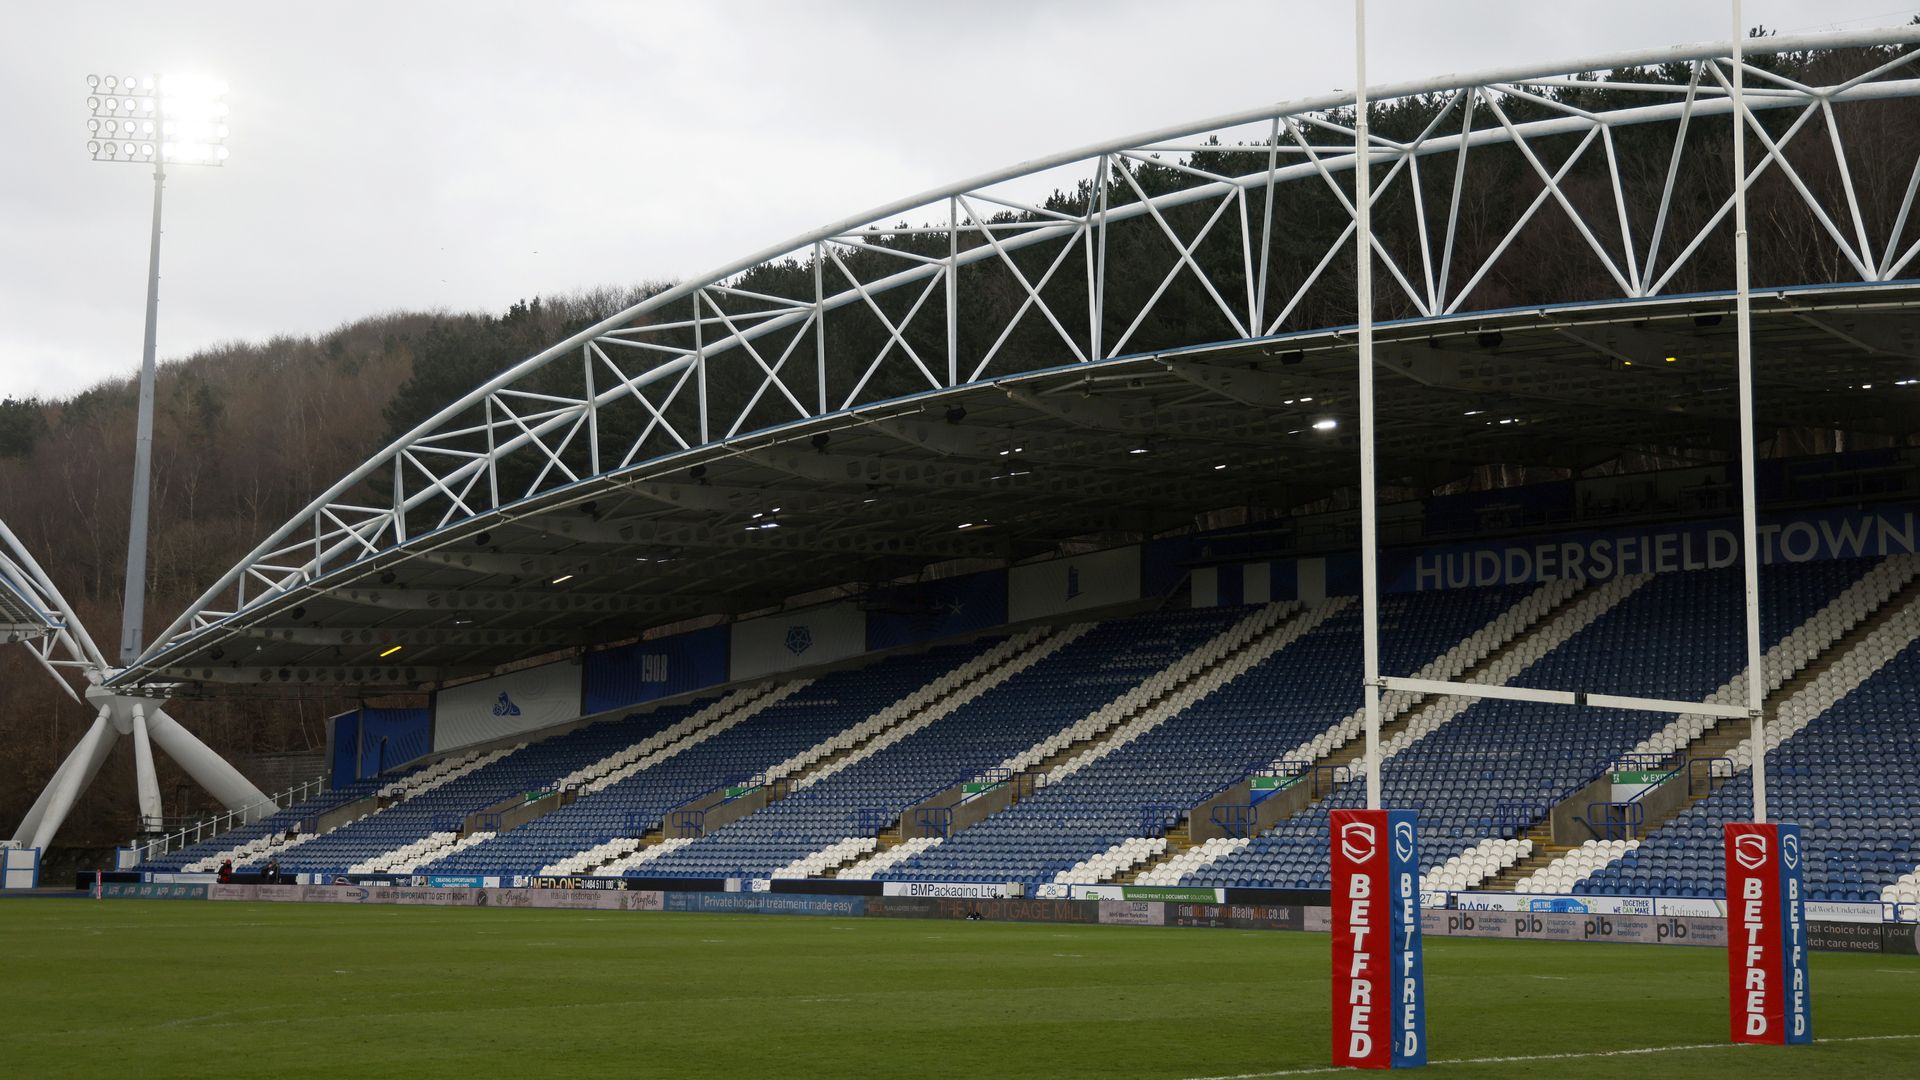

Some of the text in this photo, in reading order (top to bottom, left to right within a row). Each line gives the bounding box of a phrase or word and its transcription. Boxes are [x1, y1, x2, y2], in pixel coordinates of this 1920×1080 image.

[1415, 512, 1914, 591] HUDDERSFIELD TOWN
[641, 654, 668, 682] 1908
[596, 880, 605, 889] 511
[605, 880, 614, 890] 100
[753, 880, 762, 890] 29
[911, 884, 997, 898] BMPackaging Ltd
[1046, 886, 1057, 896] 28
[400, 891, 428, 900] IMPORTANT
[428, 892, 436, 900] TO
[436, 892, 446, 900] GET
[452, 892, 468, 900] RIGHT
[1420, 893, 1432, 904] 27
[1622, 899, 1649, 907] TOGETHER
[704, 896, 733, 908] Private
[733, 896, 765, 911] hospital
[766, 898, 807, 910] treatment
[808, 898, 832, 911] made
[833, 901, 853, 914] easy
[938, 901, 965, 916] THE
[968, 901, 1050, 920] MORTGAGE
[1133, 903, 1148, 911] NHS
[1622, 906, 1633, 914] CAN
[1817, 904, 1835, 913] Work
[1448, 914, 1474, 934] pib
[1515, 915, 1543, 936] pib
[1584, 917, 1613, 939] pib
[1656, 919, 1687, 941] pib
[1807, 924, 1910, 938] irst choice for all your
[1808, 937, 1880, 950] itch care needs
[1400, 872, 1418, 1057] BETFRED
[1742, 877, 1767, 1036] BETFRED
[1788, 878, 1805, 1036] BETFRED
[1349, 873, 1372, 1058] BETFRED
